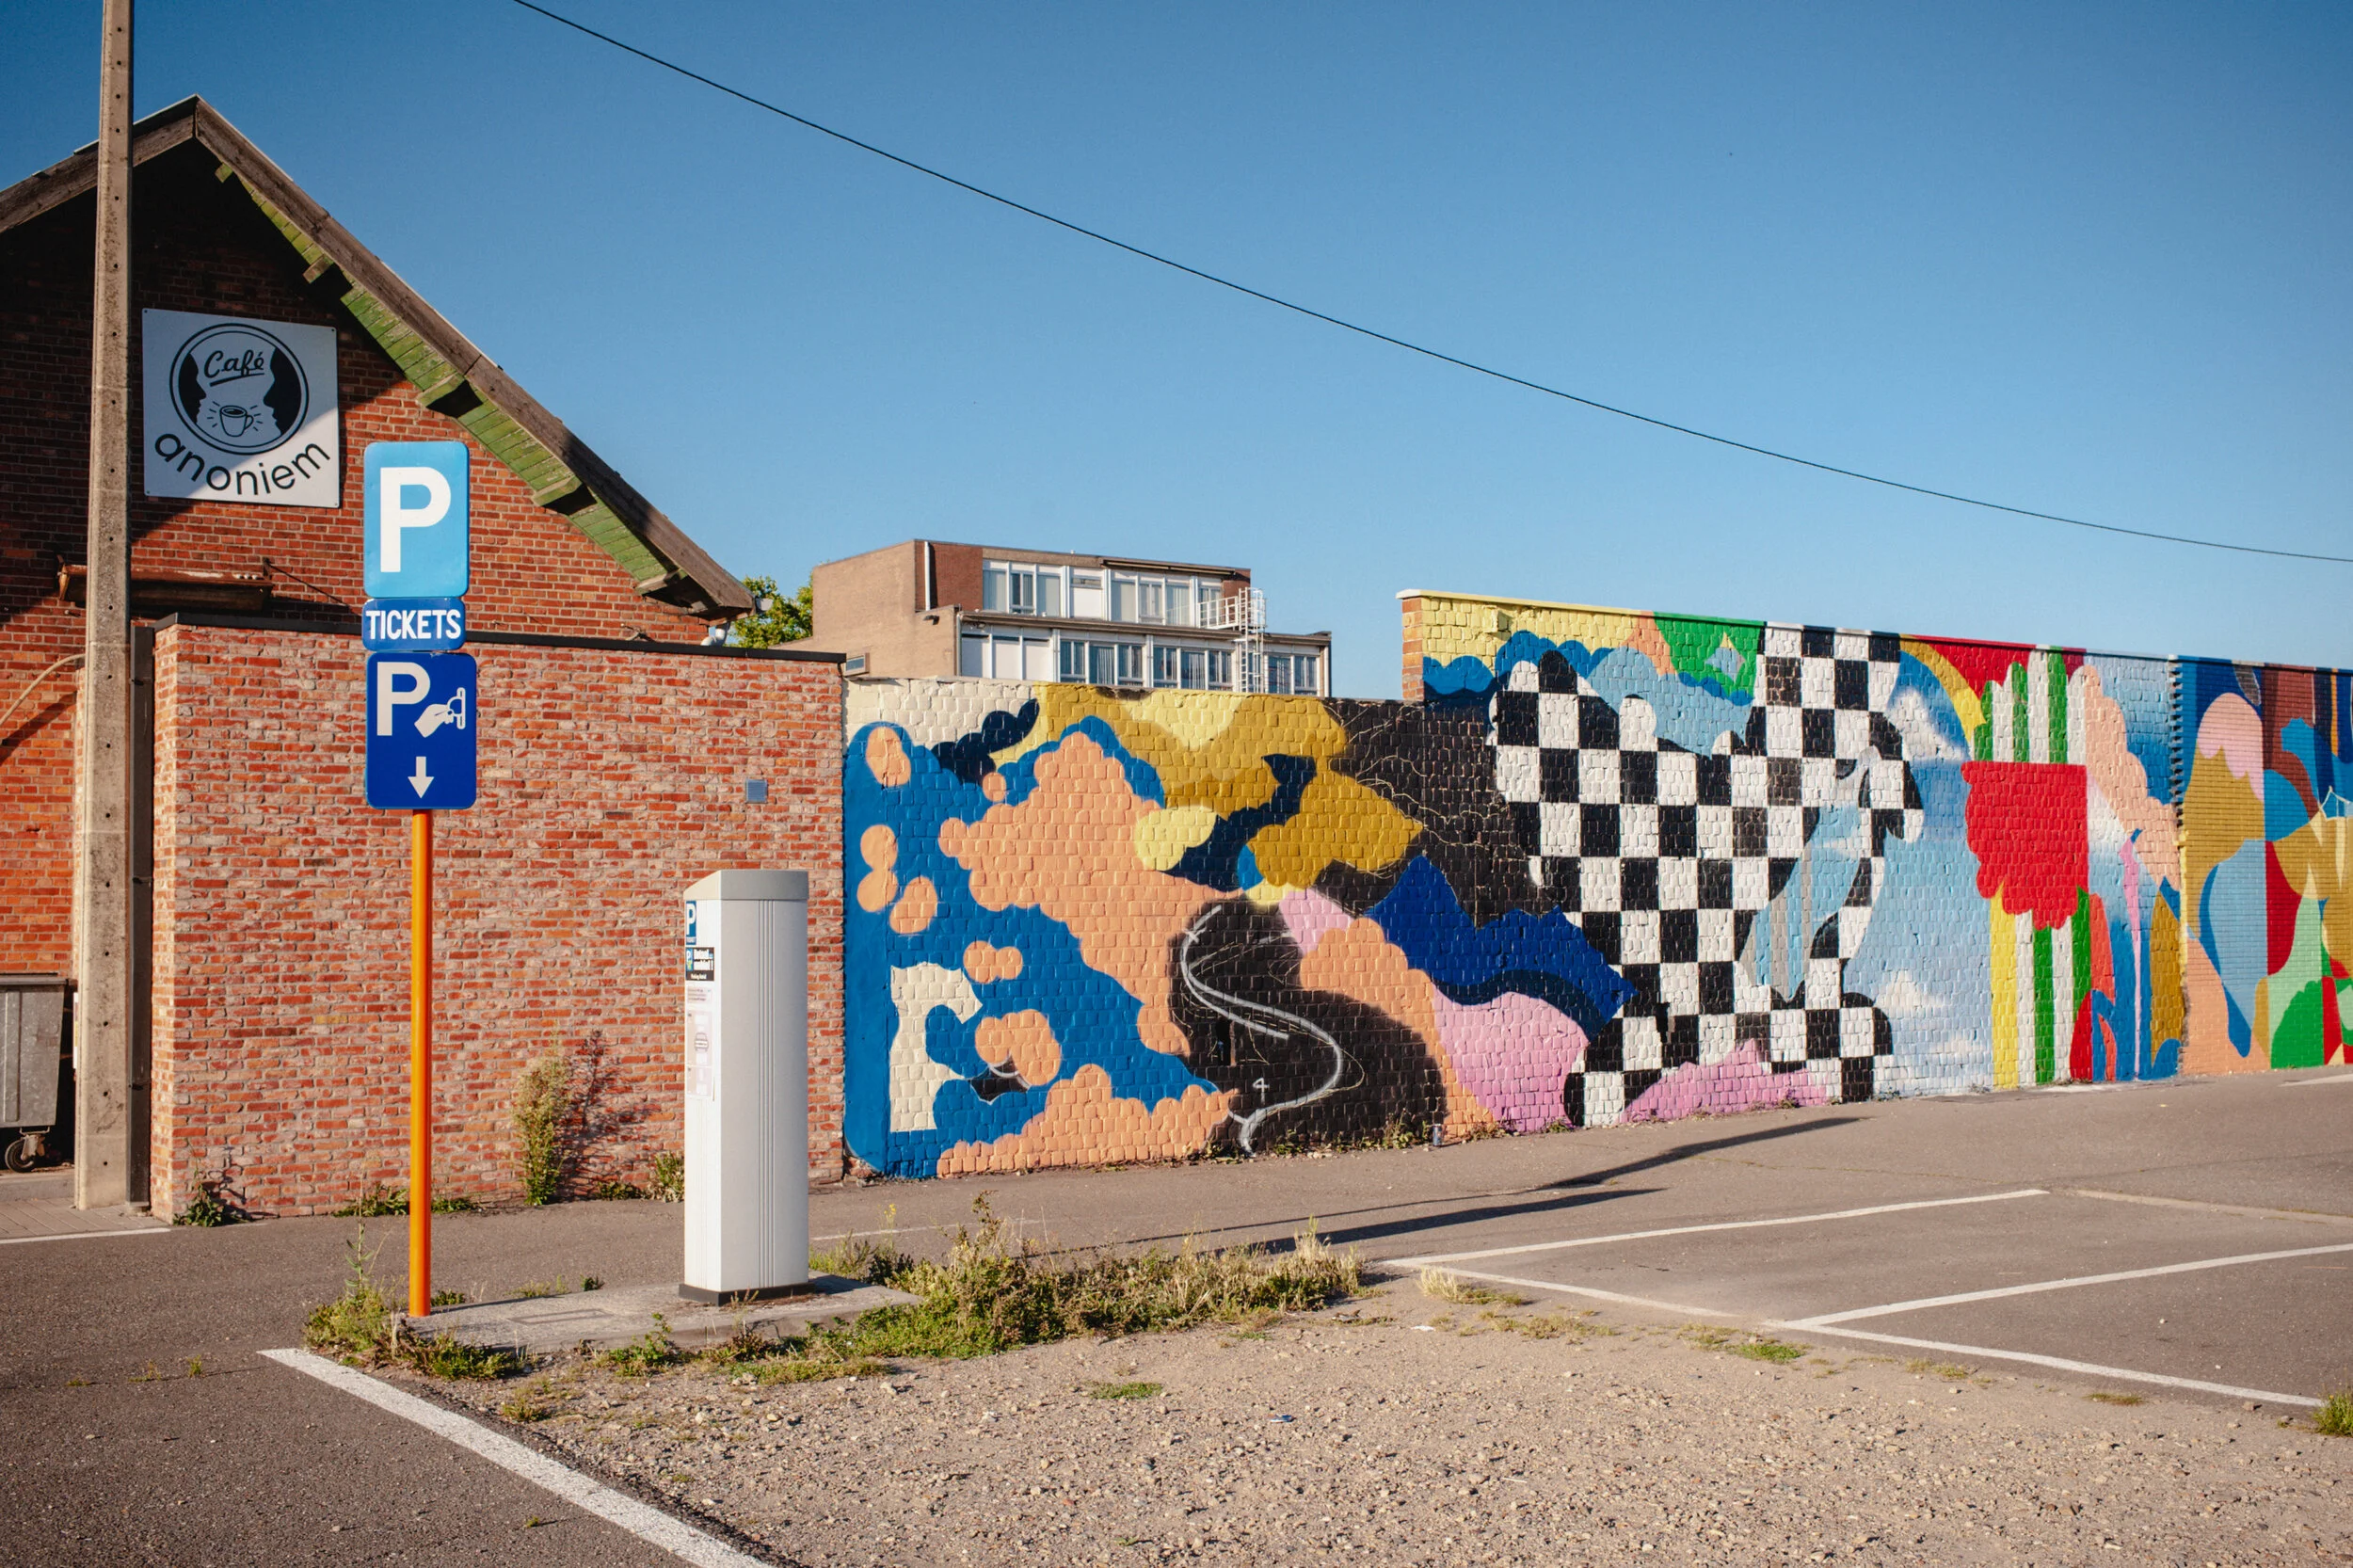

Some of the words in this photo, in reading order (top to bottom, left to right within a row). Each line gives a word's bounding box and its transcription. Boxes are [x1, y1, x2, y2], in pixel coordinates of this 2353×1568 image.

[204, 349, 264, 379] Café
[154, 434, 330, 495] anoniem
[380, 467, 452, 572] P
[365, 609, 461, 641] TICKETS
[376, 662, 431, 736] P
[686, 903, 696, 935] P
